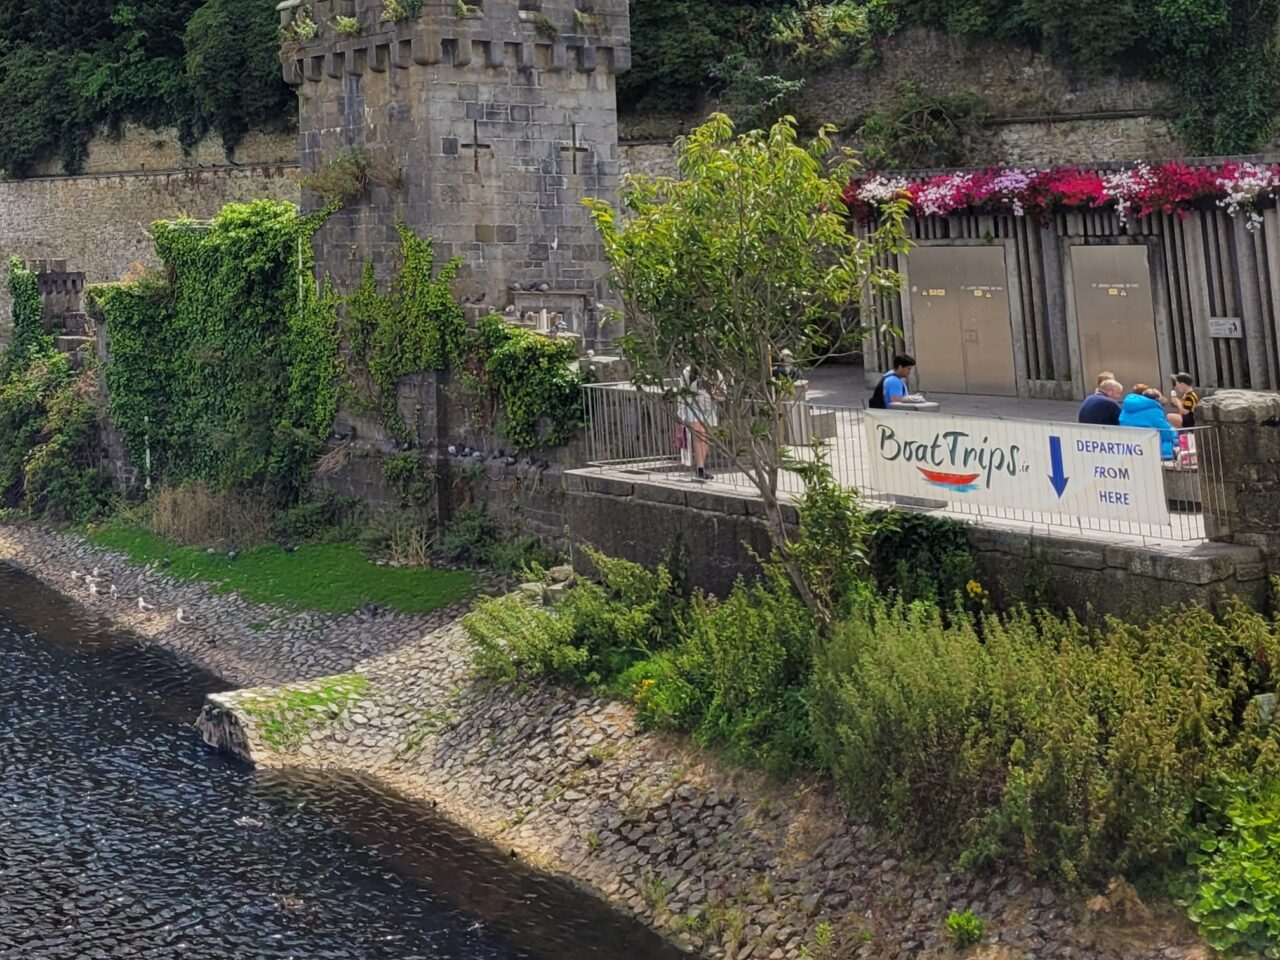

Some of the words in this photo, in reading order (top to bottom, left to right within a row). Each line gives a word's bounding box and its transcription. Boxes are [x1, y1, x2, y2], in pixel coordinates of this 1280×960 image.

[1076, 439, 1144, 456] DEPARTING
[1093, 466, 1130, 480] FROM
[1099, 490, 1130, 506] HERE
